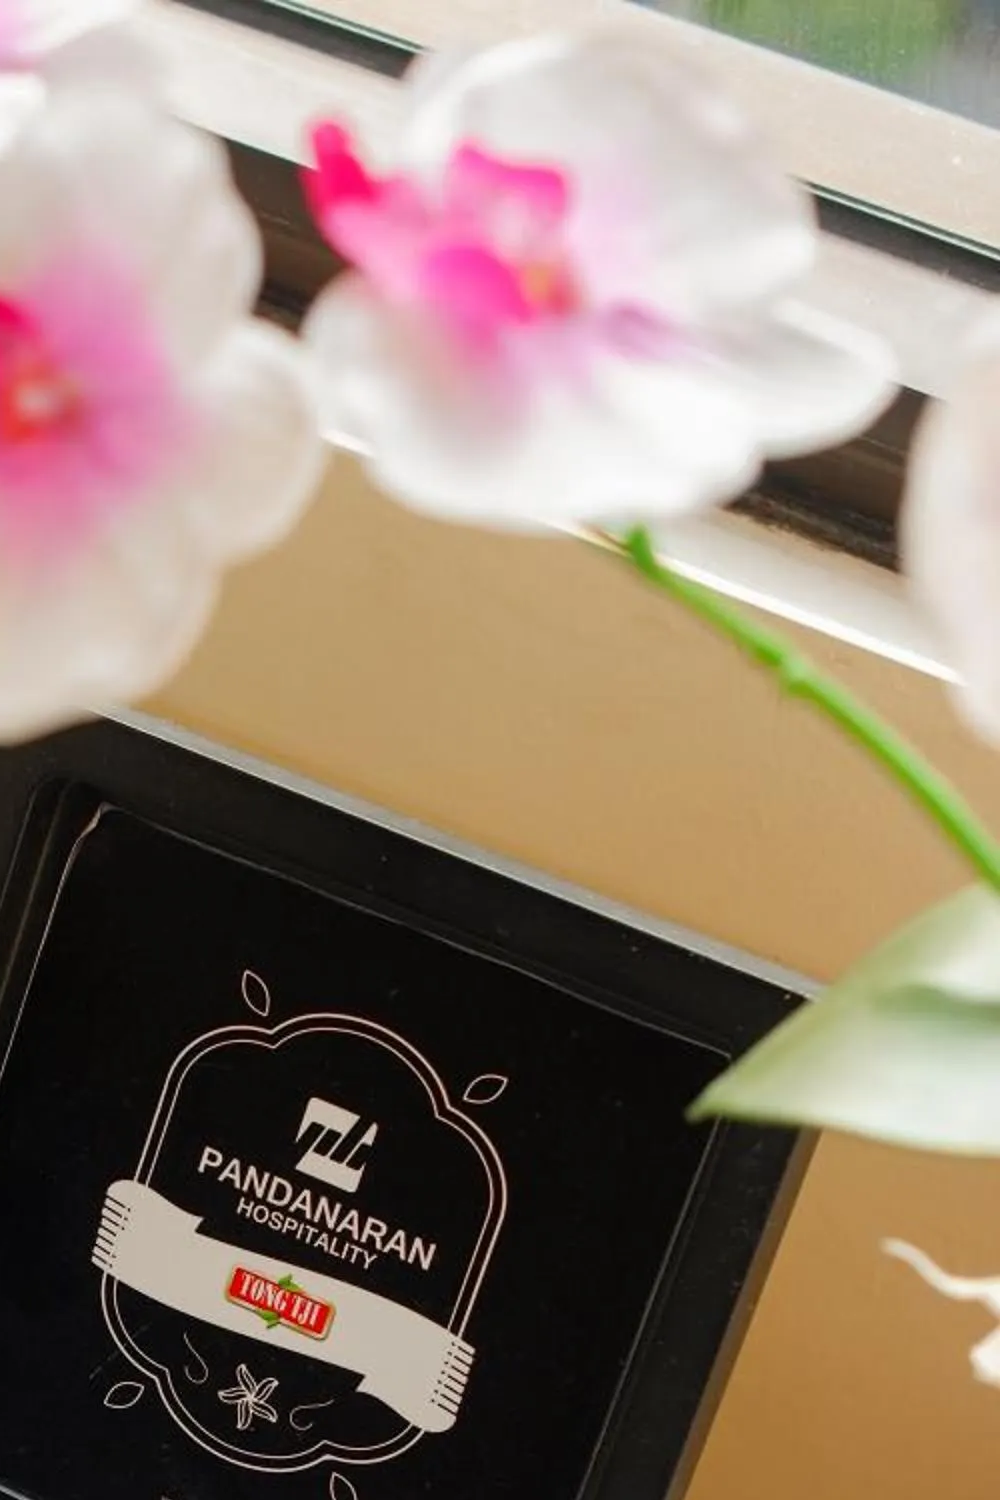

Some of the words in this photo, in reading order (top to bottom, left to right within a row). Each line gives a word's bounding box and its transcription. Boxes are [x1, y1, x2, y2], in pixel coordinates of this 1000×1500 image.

[197, 1145, 437, 1271] PANDANARAN
[236, 1196, 378, 1270] HOSPITALITY
[238, 1270, 290, 1313] TONG
[289, 1290, 322, 1329] TJI
